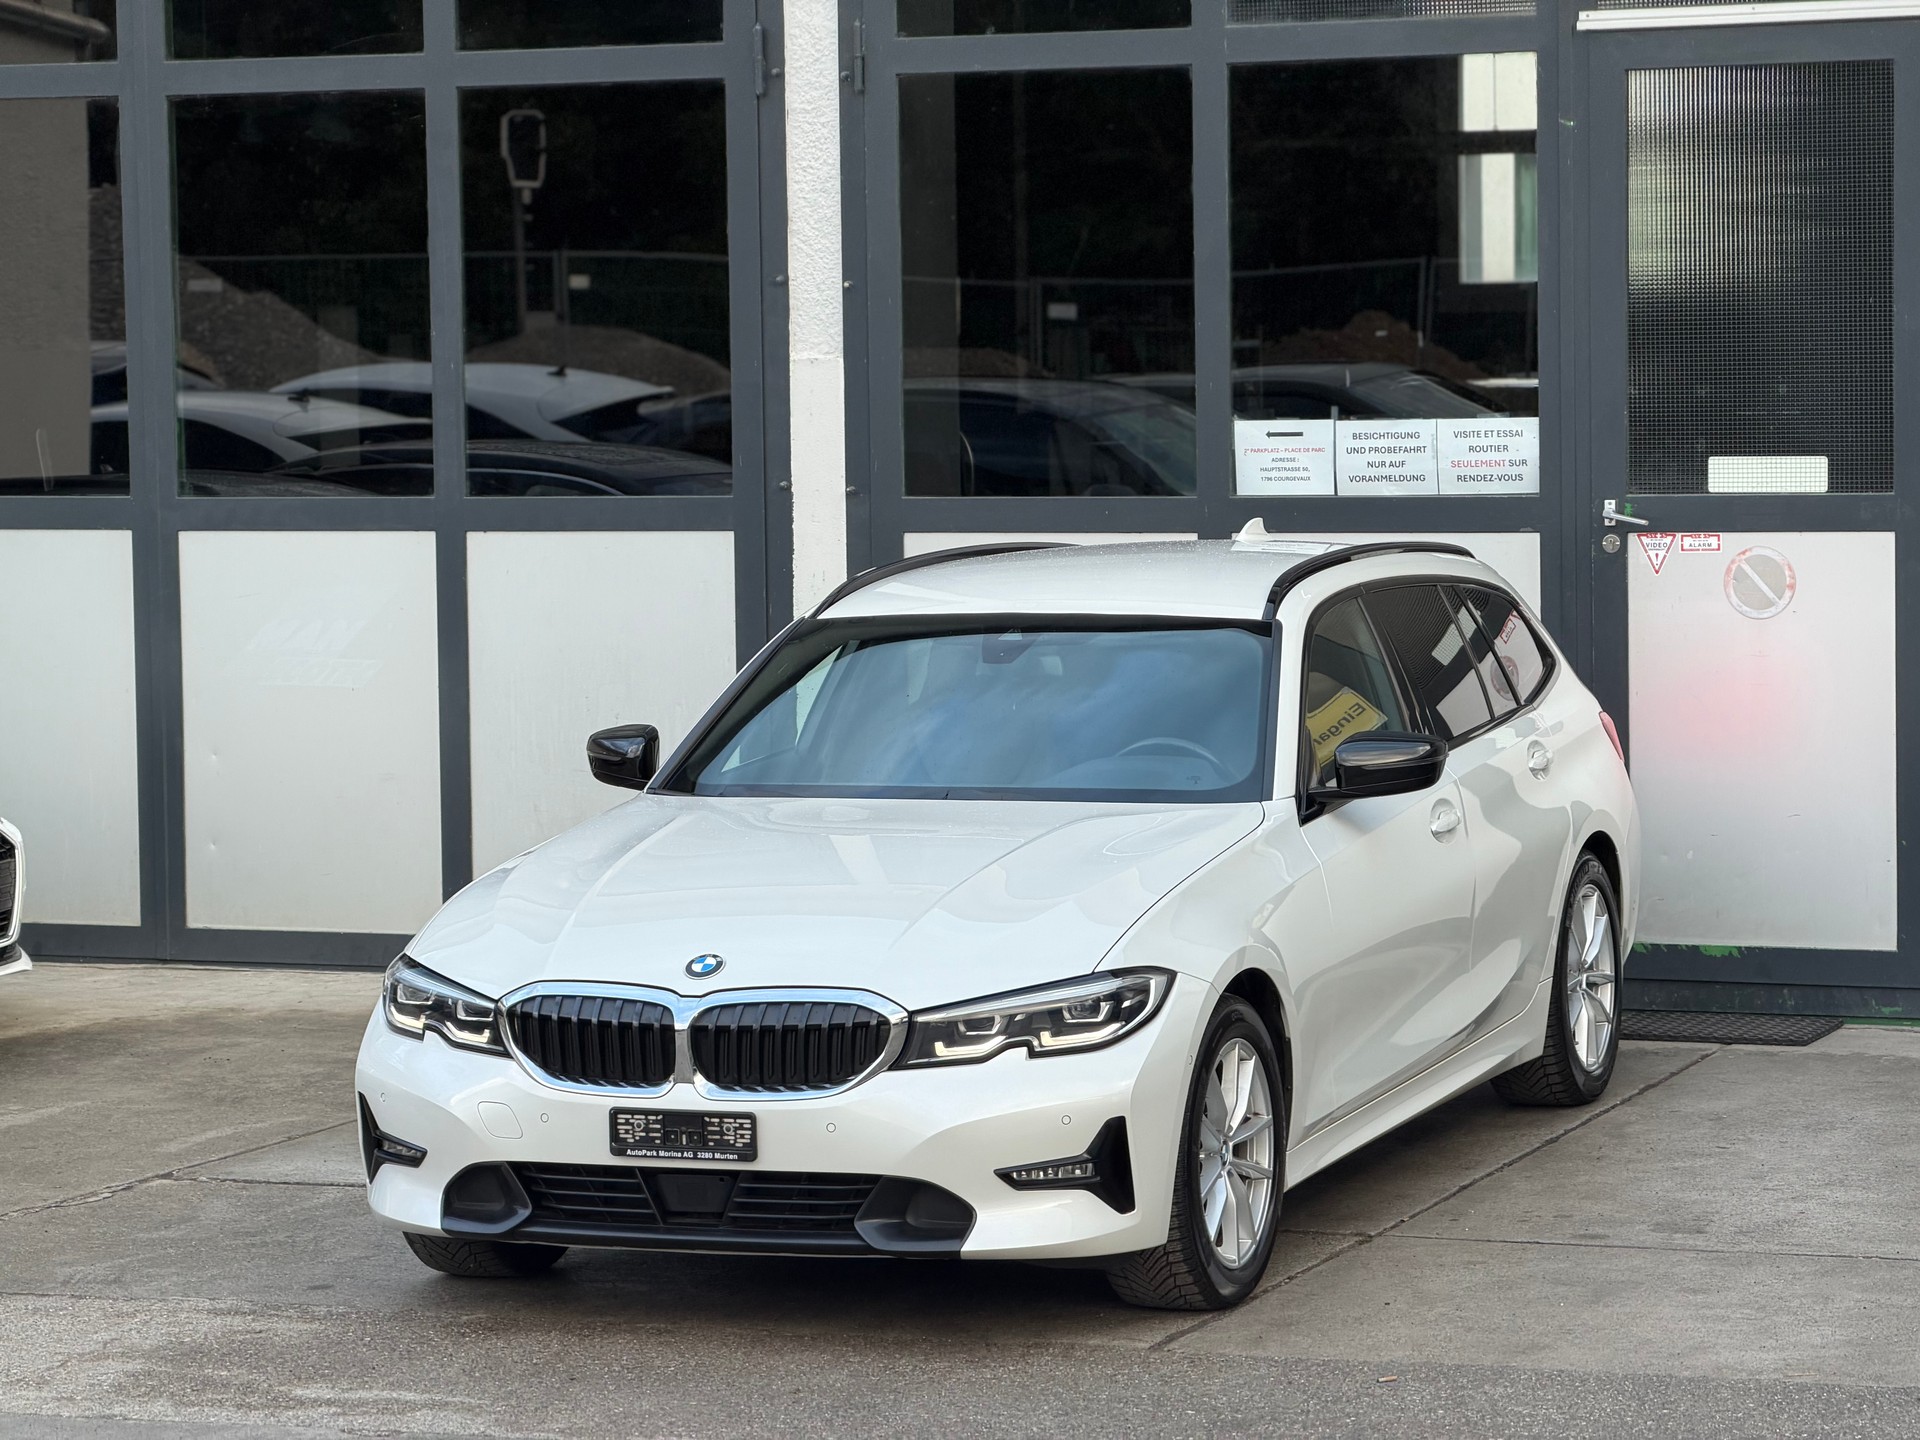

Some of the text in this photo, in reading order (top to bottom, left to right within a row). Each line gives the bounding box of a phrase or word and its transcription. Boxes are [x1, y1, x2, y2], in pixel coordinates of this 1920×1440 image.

[1352, 431, 1421, 440] BESICHTIGUNG
[1453, 429, 1523, 438] VISITE ET ESSAI
[1346, 445, 1427, 454] UND PROBEFAHRT
[1468, 445, 1509, 453] ROUTIER
[1367, 460, 1406, 468] NUR AUF
[1450, 459, 1528, 468] SEULEMENT SUR
[1348, 474, 1426, 483] VORANMELDUNG
[1456, 473, 1524, 482] RENDEZ-VOUS
[626, 1149, 657, 1157] AutoPark
[714, 1152, 738, 1160] Murten
